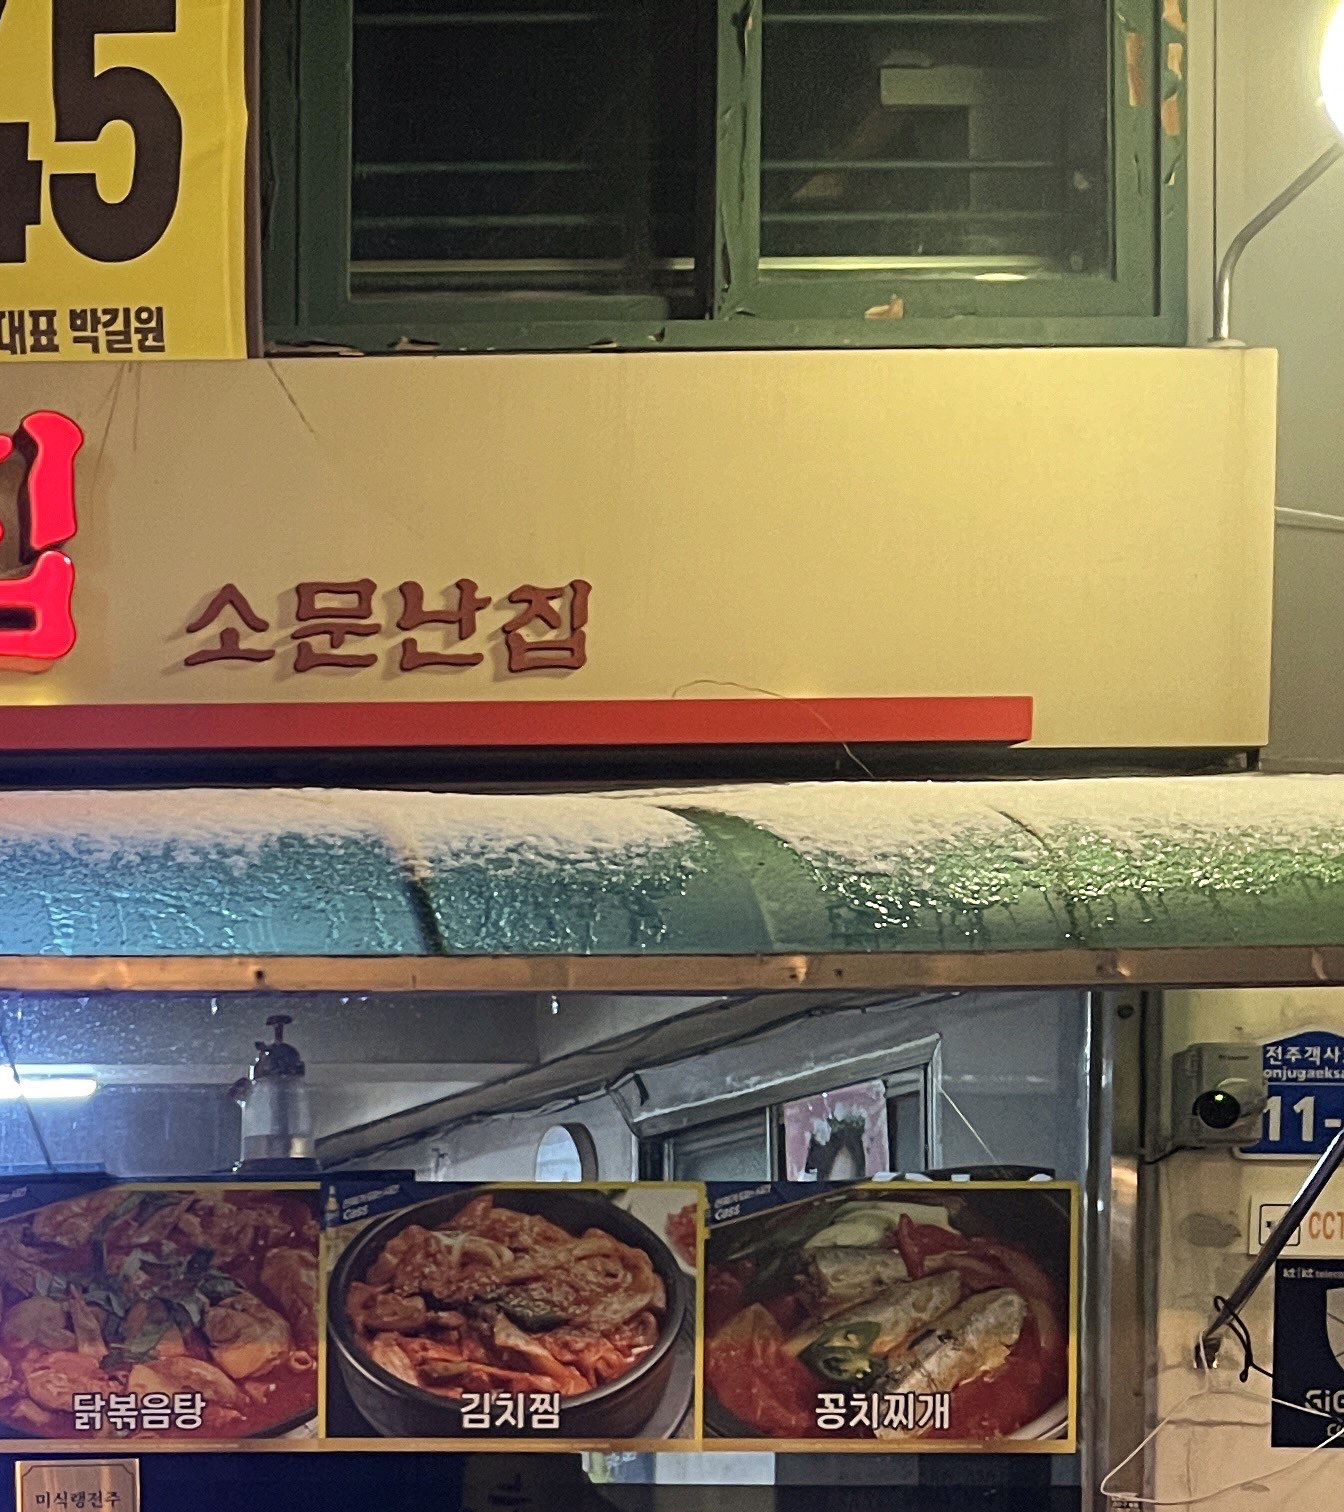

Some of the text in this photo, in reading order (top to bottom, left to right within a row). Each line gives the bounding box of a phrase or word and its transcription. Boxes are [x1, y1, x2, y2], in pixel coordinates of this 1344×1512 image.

[69, 307, 167, 354] 박길원
[184, 577, 592, 672] 소문난집
[1266, 1046, 1344, 1066] 전주객사
[74, 1393, 206, 1430] 닭볶음탕
[459, 1393, 561, 1429] 김치찜
[815, 1392, 950, 1429] 꽁치찌개
